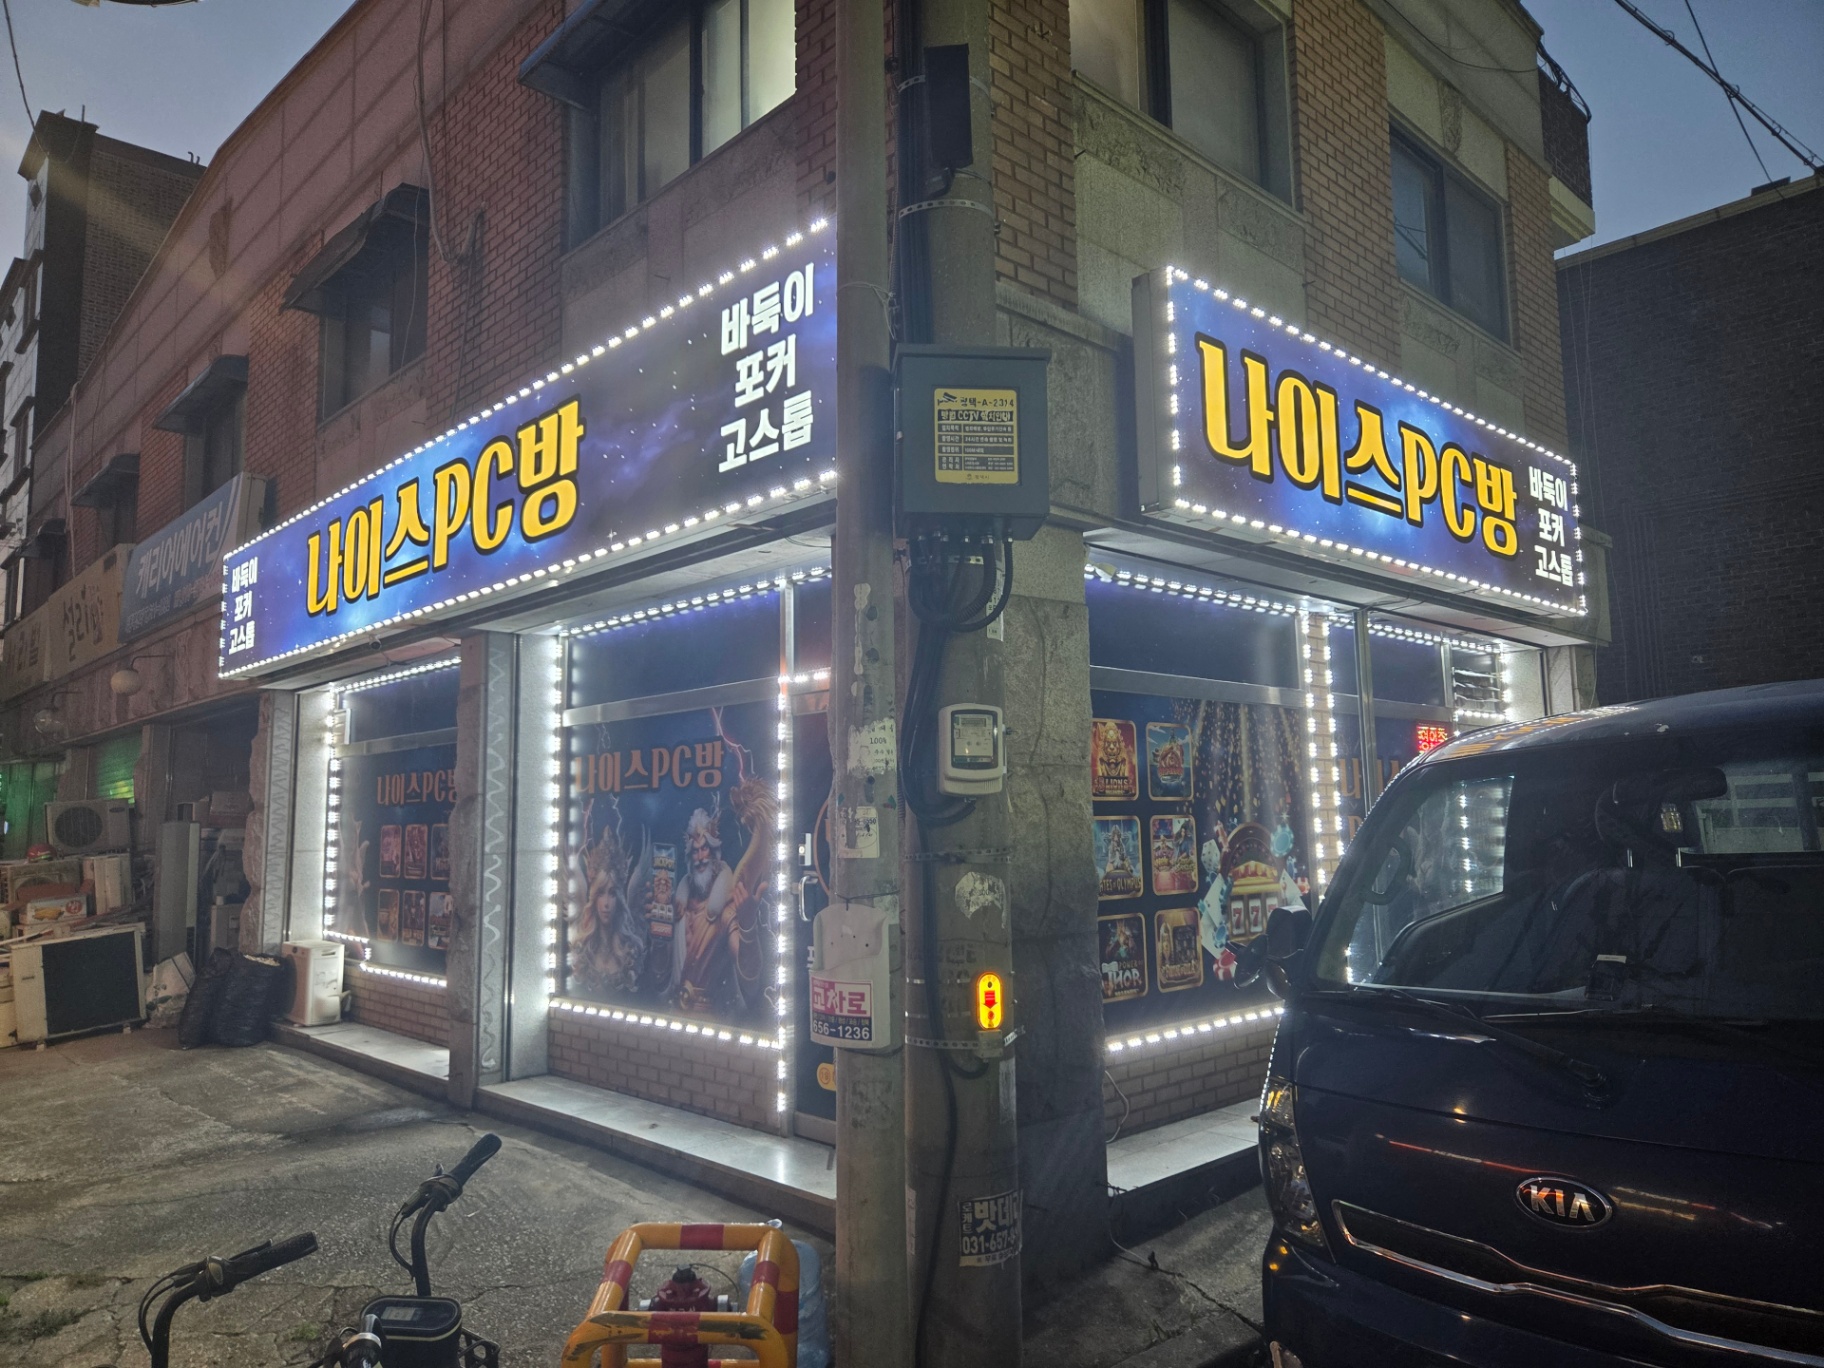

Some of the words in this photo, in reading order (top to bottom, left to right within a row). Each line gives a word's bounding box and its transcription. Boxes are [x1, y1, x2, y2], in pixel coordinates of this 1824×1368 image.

[720, 264, 814, 356] 바둑이
[735, 335, 797, 408] 포커
[719, 391, 813, 473] 고스톱
[958, 411, 979, 420] CCTV
[1199, 340, 1518, 556] 나이스PC방
[307, 401, 584, 615] 나이스PC방
[1528, 466, 1569, 512] 바둑이
[1538, 509, 1566, 547] 포커
[231, 557, 259, 591] 바둑이
[1535, 545, 1573, 588] 고스톱
[233, 597, 253, 623] 포커
[228, 626, 256, 656] 고스톱
[574, 739, 724, 794] 나이스PC방
[813, 986, 867, 1014] 교차로
[813, 1020, 870, 1040] 656-1236
[1529, 1184, 1595, 1221] KIA
